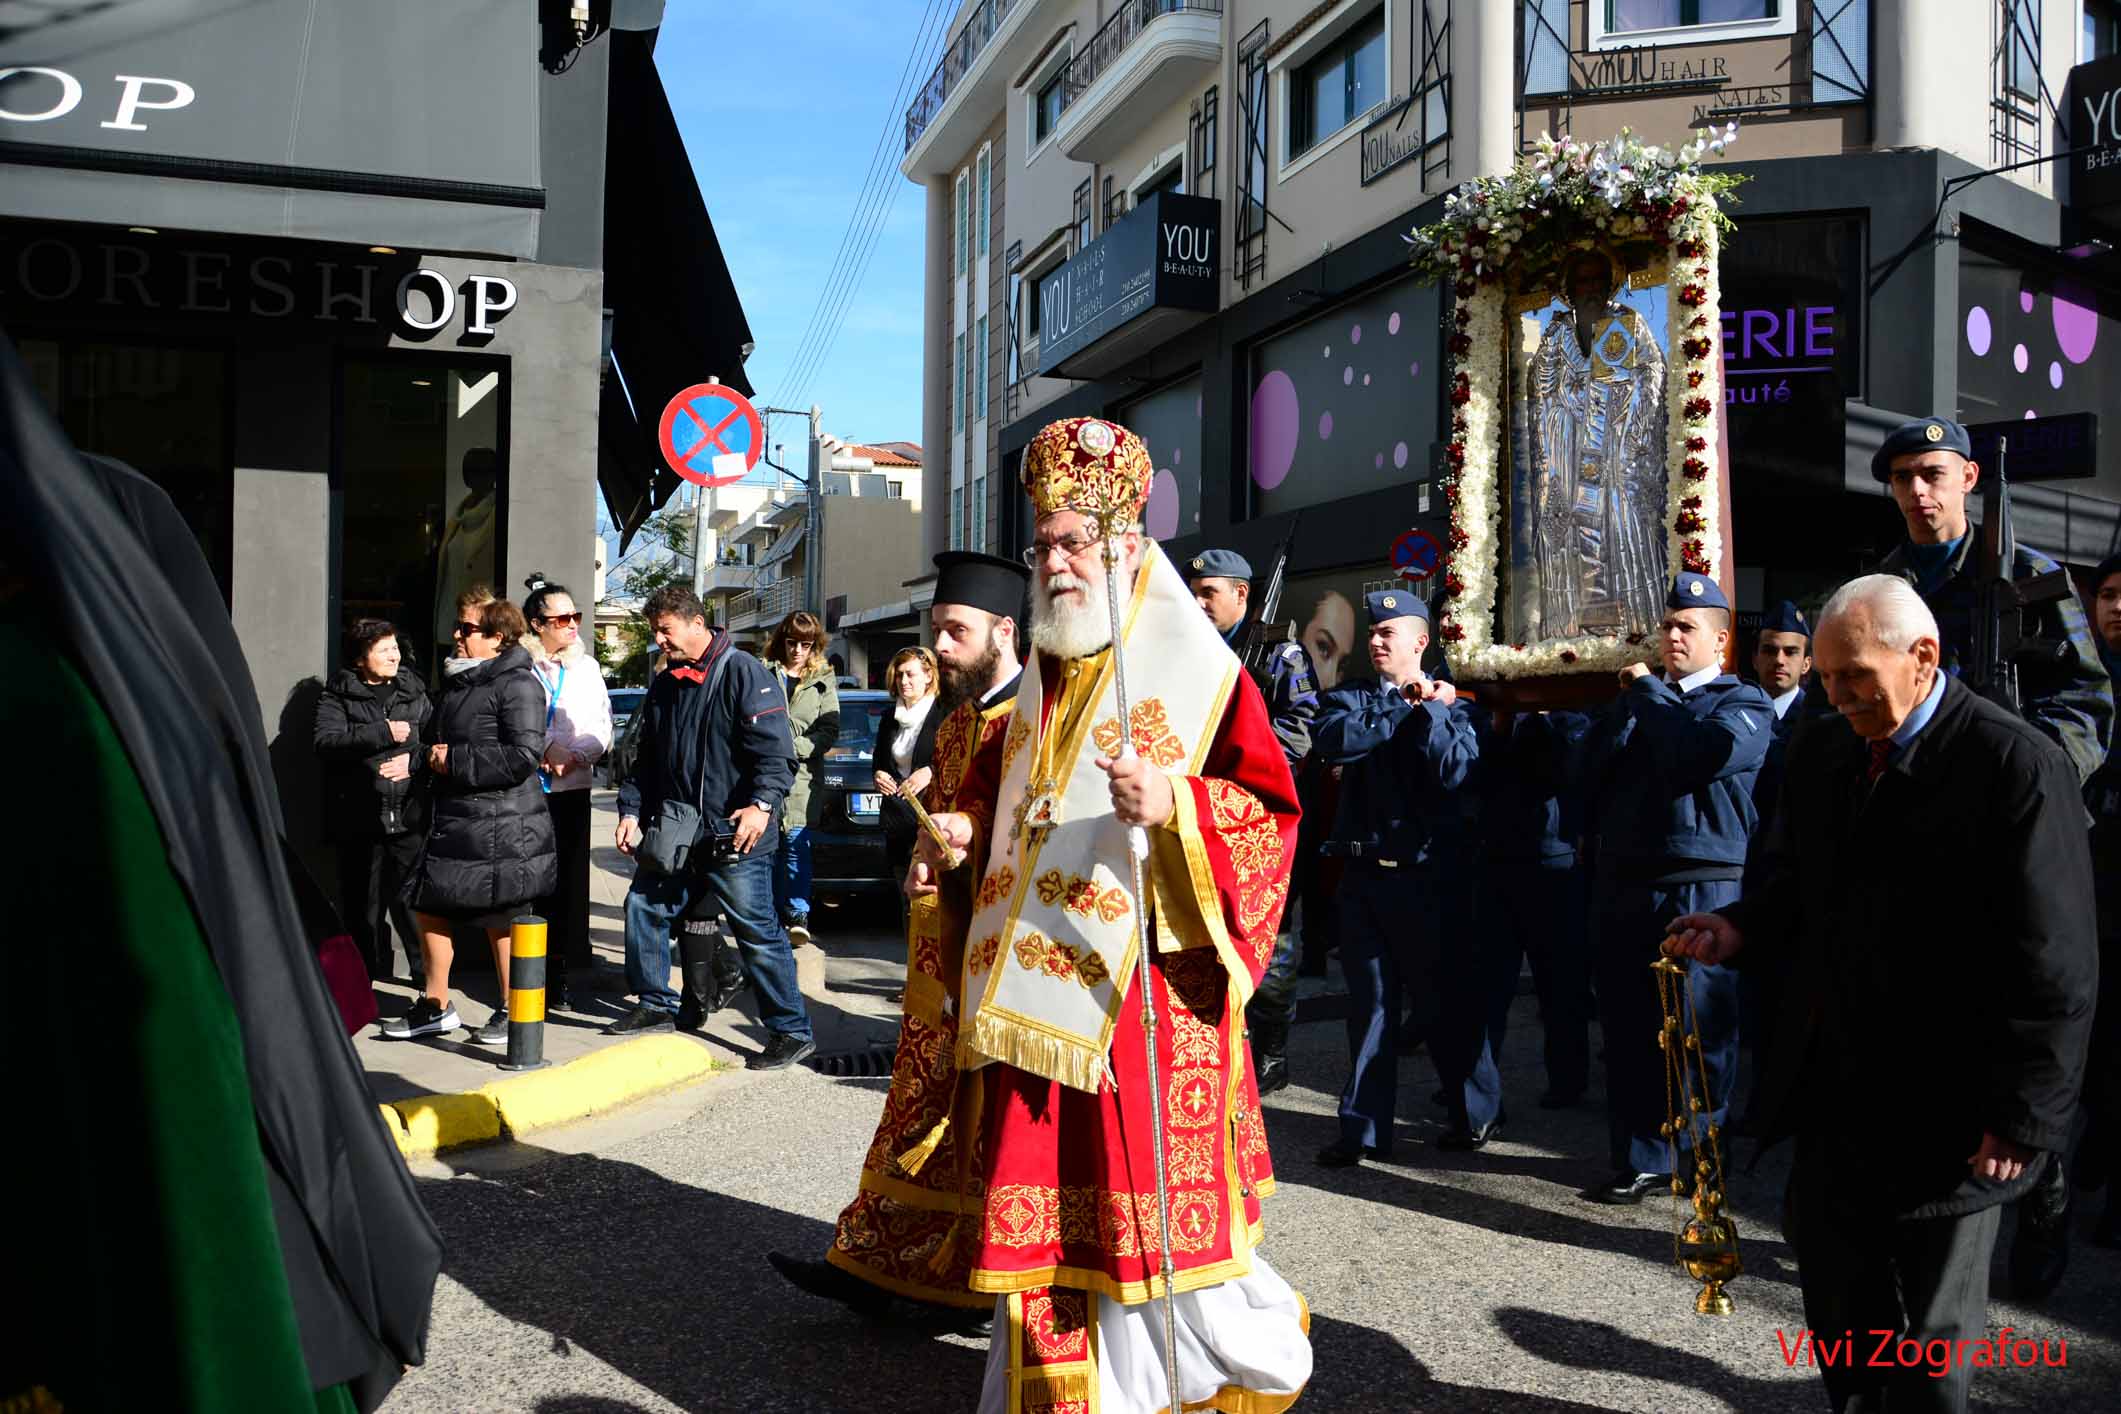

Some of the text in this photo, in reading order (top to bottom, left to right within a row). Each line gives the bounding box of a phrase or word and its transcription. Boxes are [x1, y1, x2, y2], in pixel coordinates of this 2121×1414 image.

[1660, 56, 1727, 81] HAIR
[1713, 86, 1783, 109] NAILS
[1363, 130, 1388, 181] YOU
[1162, 222, 1210, 264] YOU
[1043, 271, 1071, 345] YOU
